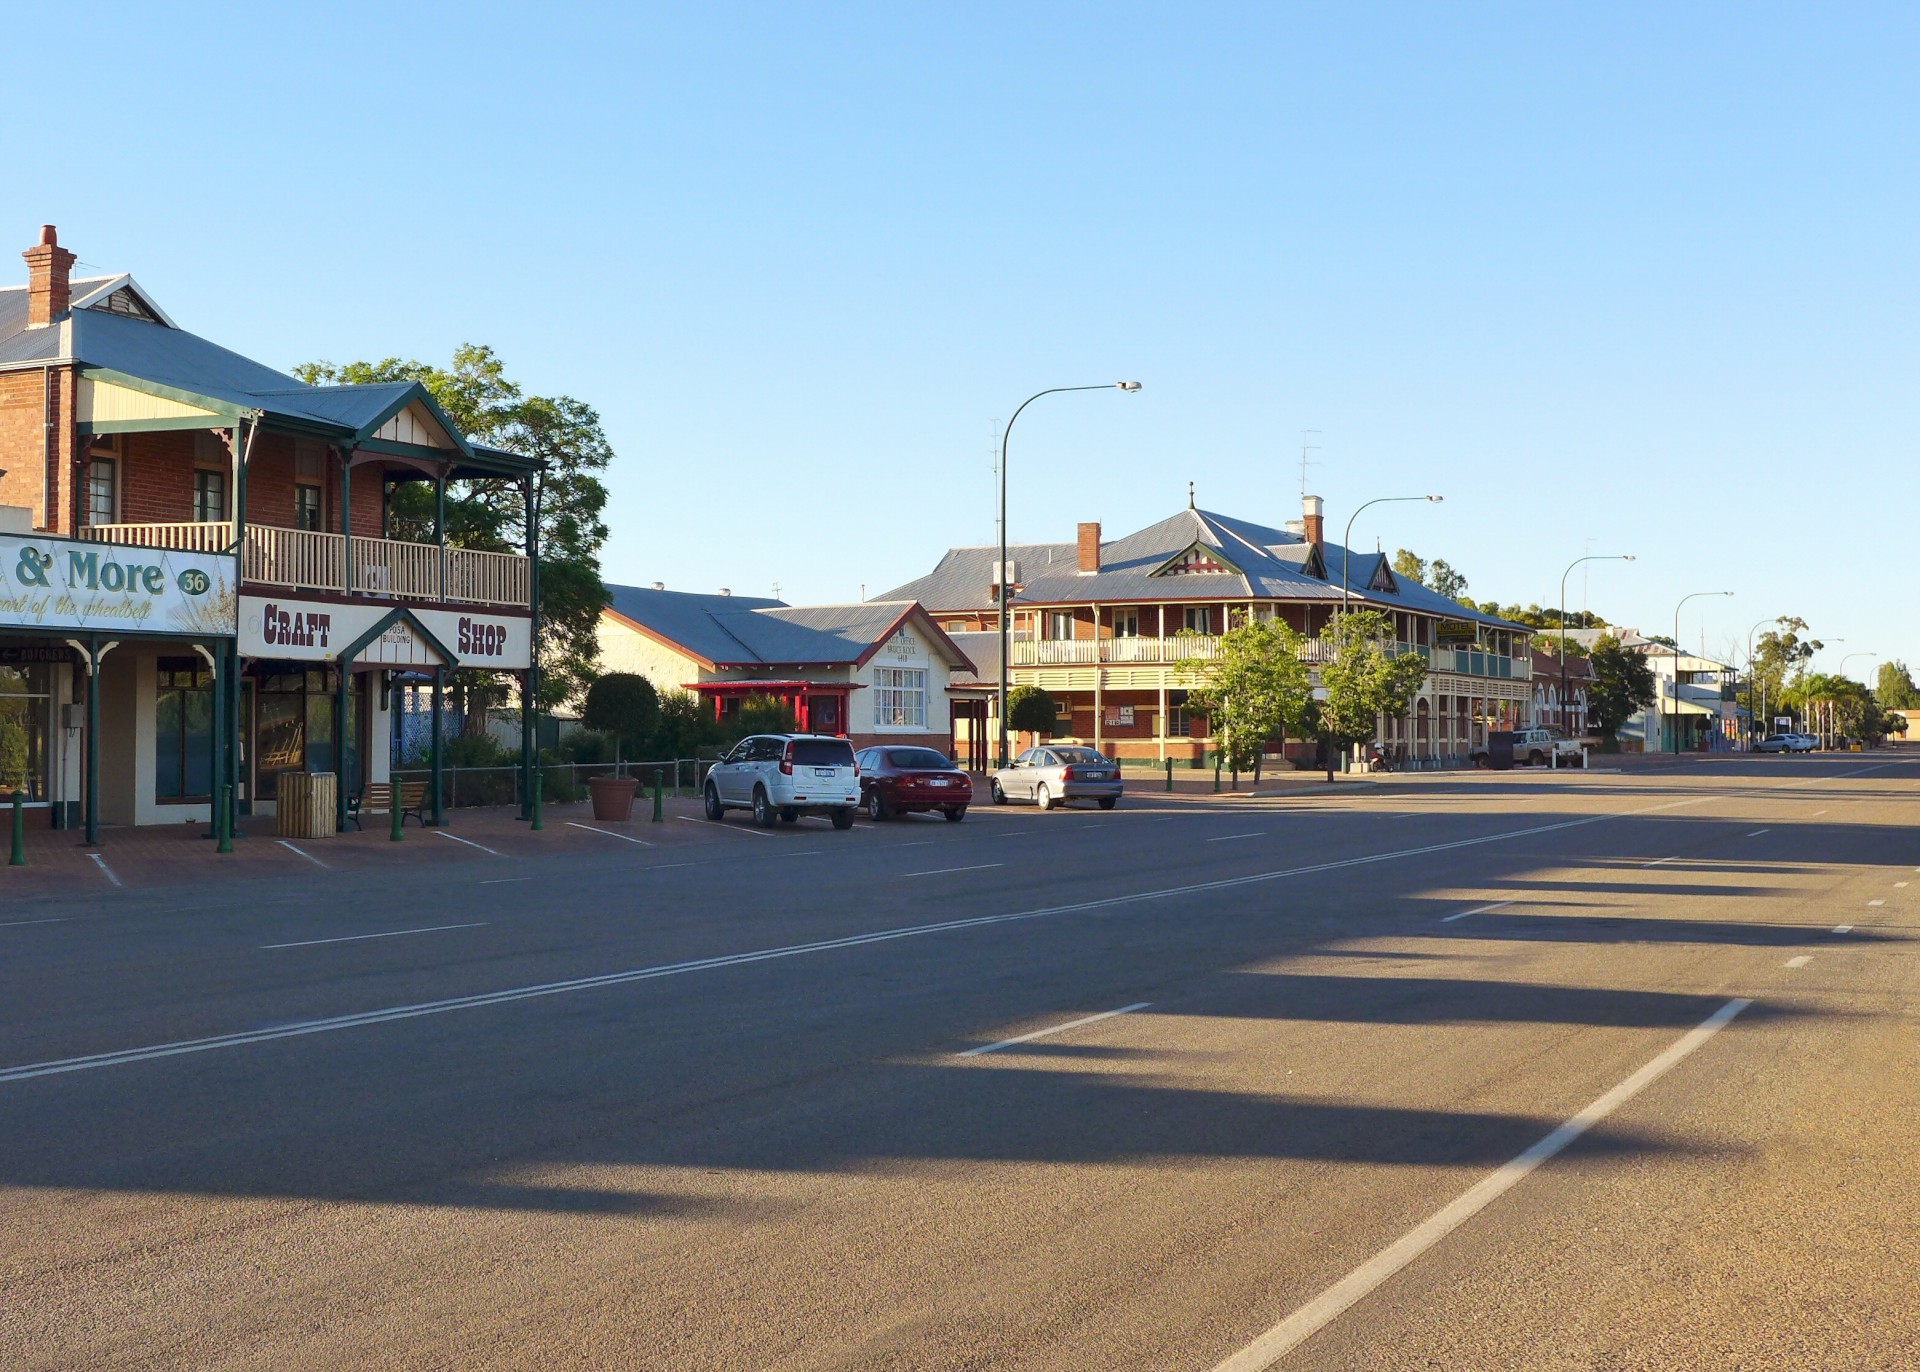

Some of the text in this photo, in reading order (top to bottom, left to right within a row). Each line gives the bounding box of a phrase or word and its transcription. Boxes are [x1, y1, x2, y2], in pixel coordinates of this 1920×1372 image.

[16, 546, 165, 595] & More
[184, 573, 204, 591] 36
[31, 595, 51, 624] of
[55, 596, 77, 615] the
[82, 598, 151, 619] wheatbelt
[263, 603, 507, 656] CRAFT SHOP
[383, 635, 410, 644] BUILDING
[900, 637, 915, 645] OFFICE
[21, 648, 72, 661] BUTCHERS
[1120, 706, 1133, 715] ICE
